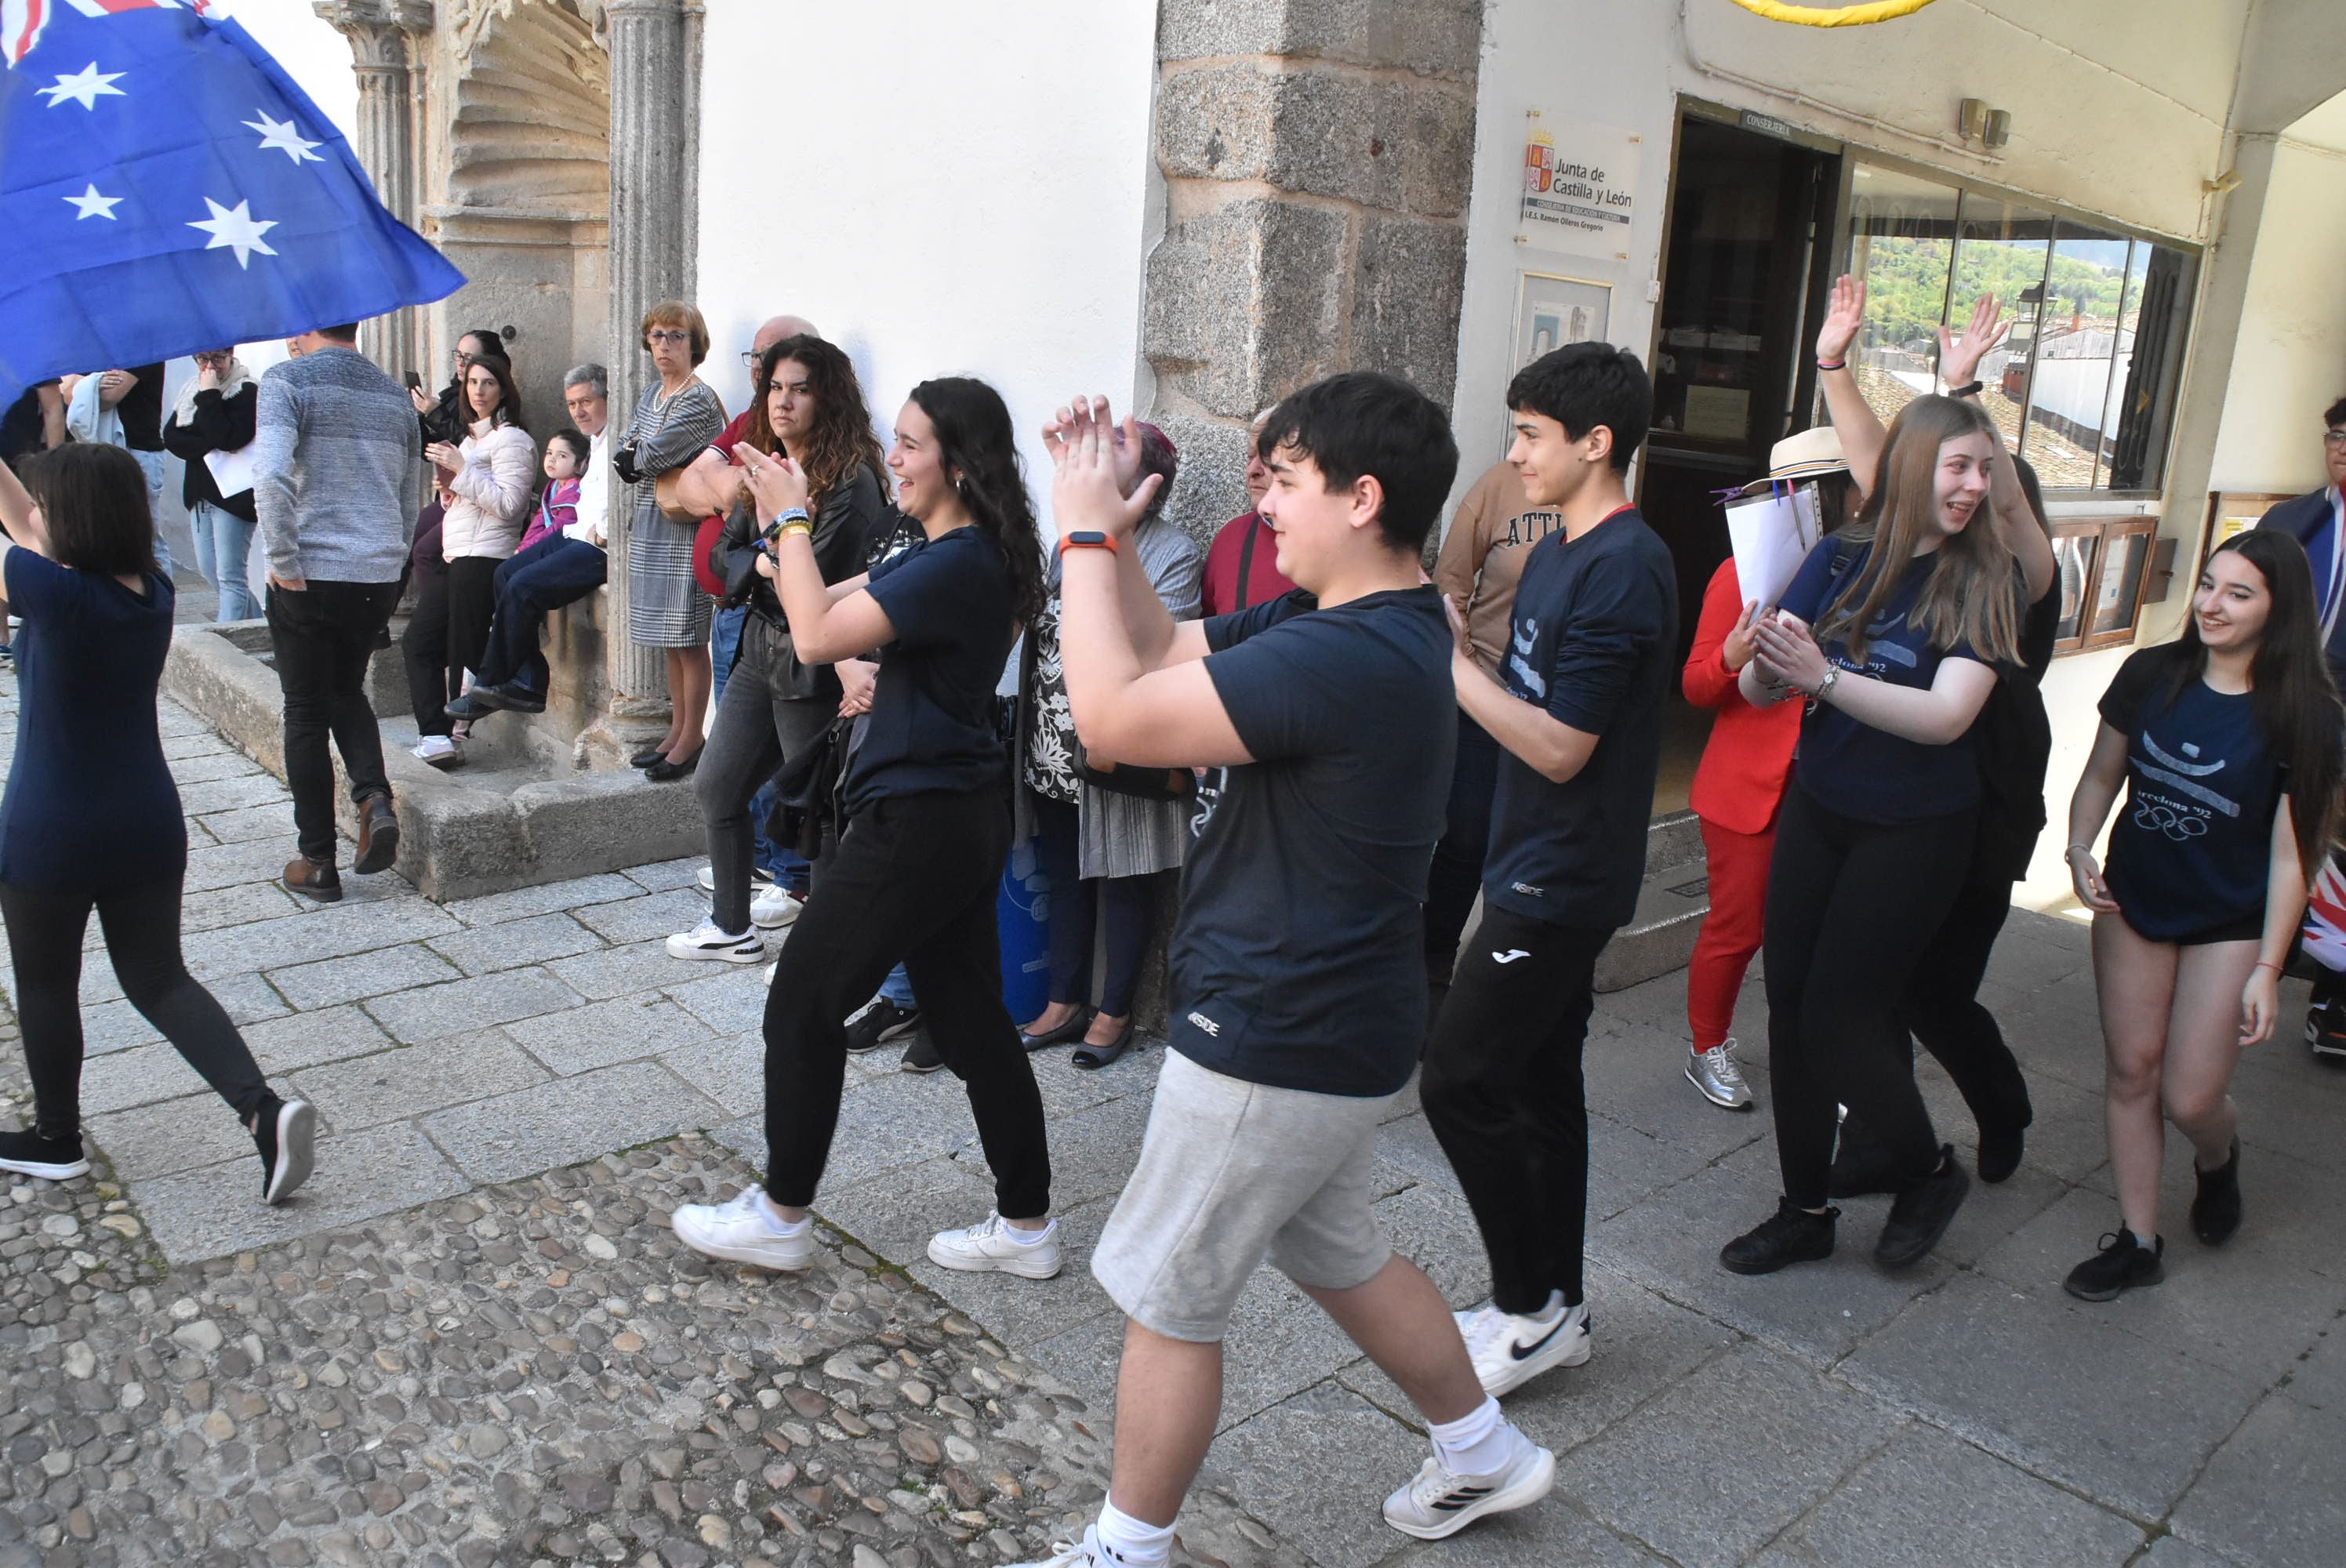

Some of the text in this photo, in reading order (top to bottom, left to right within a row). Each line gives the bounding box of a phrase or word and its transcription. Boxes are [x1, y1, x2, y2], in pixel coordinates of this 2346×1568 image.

[1556, 158, 1604, 182] Junta de
[1553, 179, 1632, 207] Castilla y León
[1540, 213, 1559, 223] Ramón
[1580, 221, 1603, 233] Gregorio
